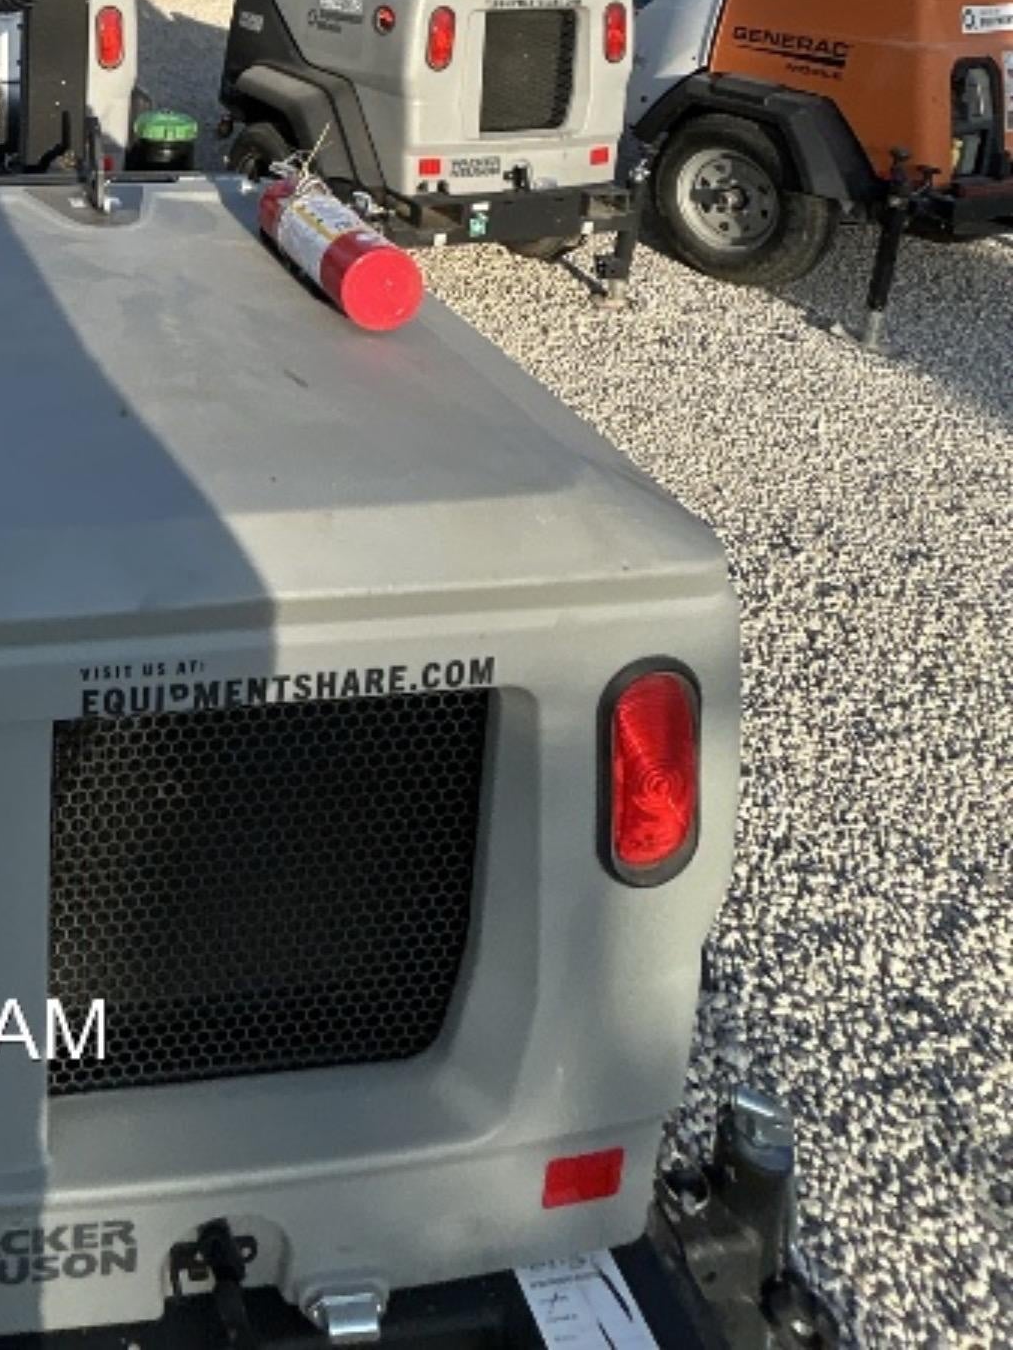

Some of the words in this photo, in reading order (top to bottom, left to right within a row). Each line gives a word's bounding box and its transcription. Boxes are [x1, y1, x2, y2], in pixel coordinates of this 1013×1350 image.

[733, 26, 848, 57] GENERAC
[79, 664, 132, 682] VISIT
[142, 661, 165, 677] US
[81, 656, 496, 718] EQUIPMENTSHARE.COM
